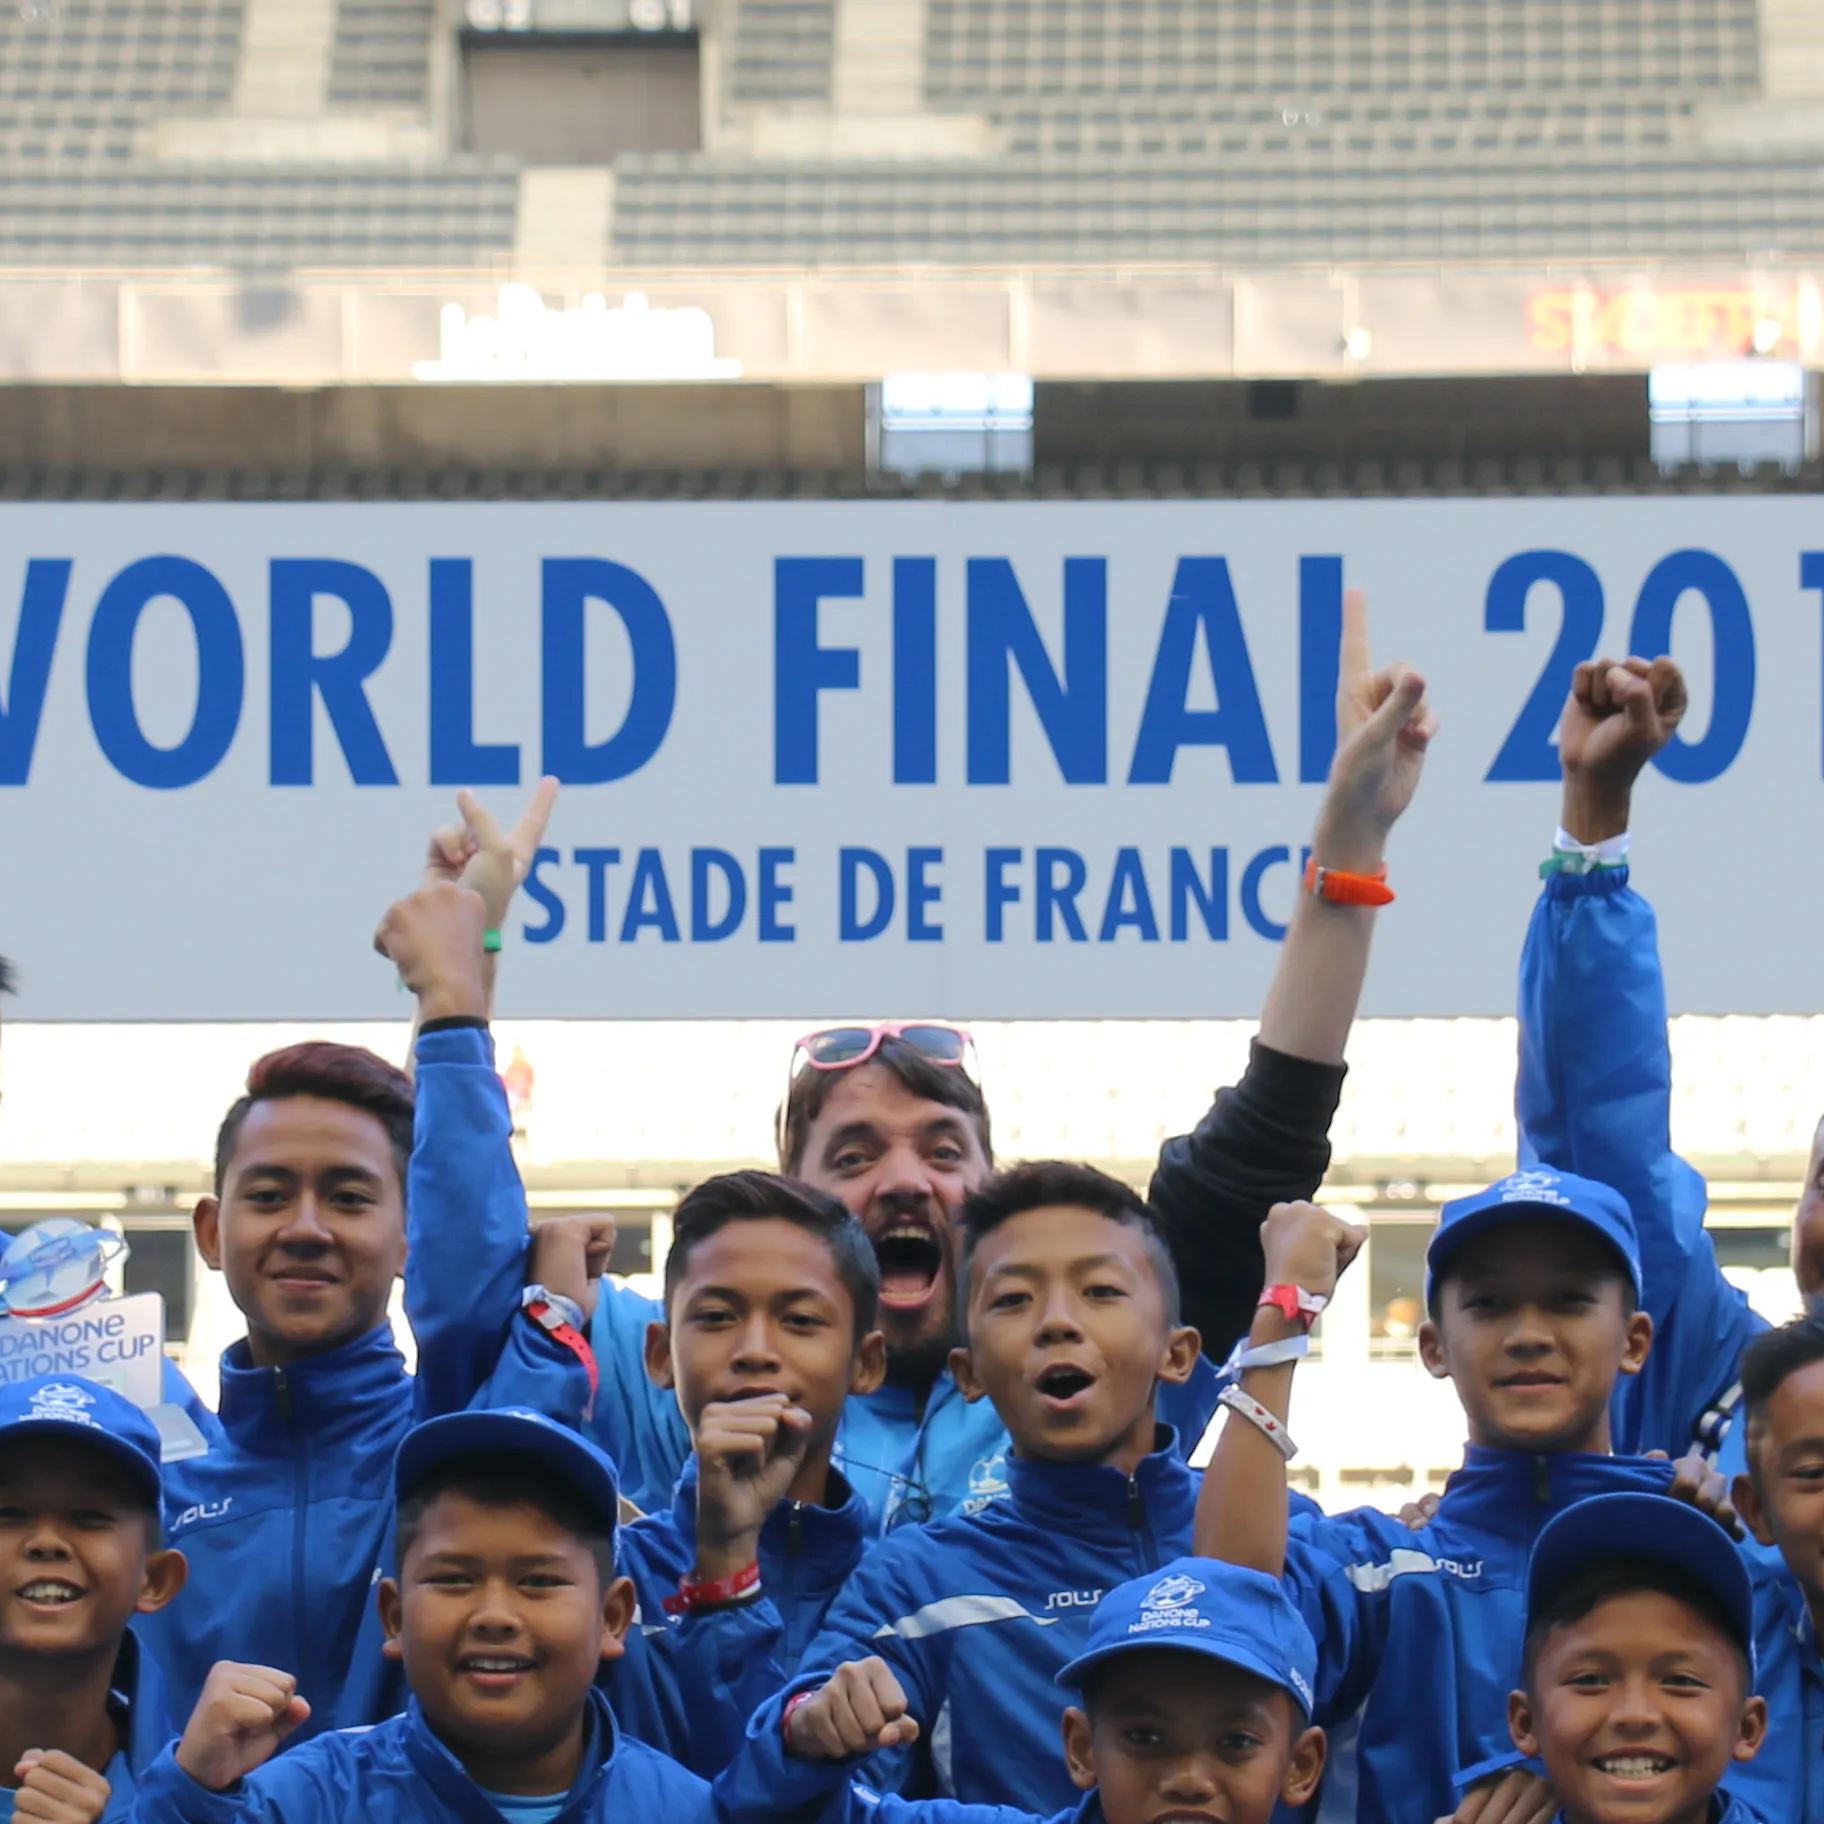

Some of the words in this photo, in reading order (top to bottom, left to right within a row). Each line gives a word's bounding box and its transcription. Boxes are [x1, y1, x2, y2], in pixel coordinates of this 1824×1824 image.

[774, 555, 1344, 786] FINAL
[522, 847, 796, 943] STADE
[838, 847, 943, 941] DE
[984, 846, 1310, 942] FRANC
[97, 1333, 156, 1365] CUP
[1182, 1616, 1213, 1629] CUP
